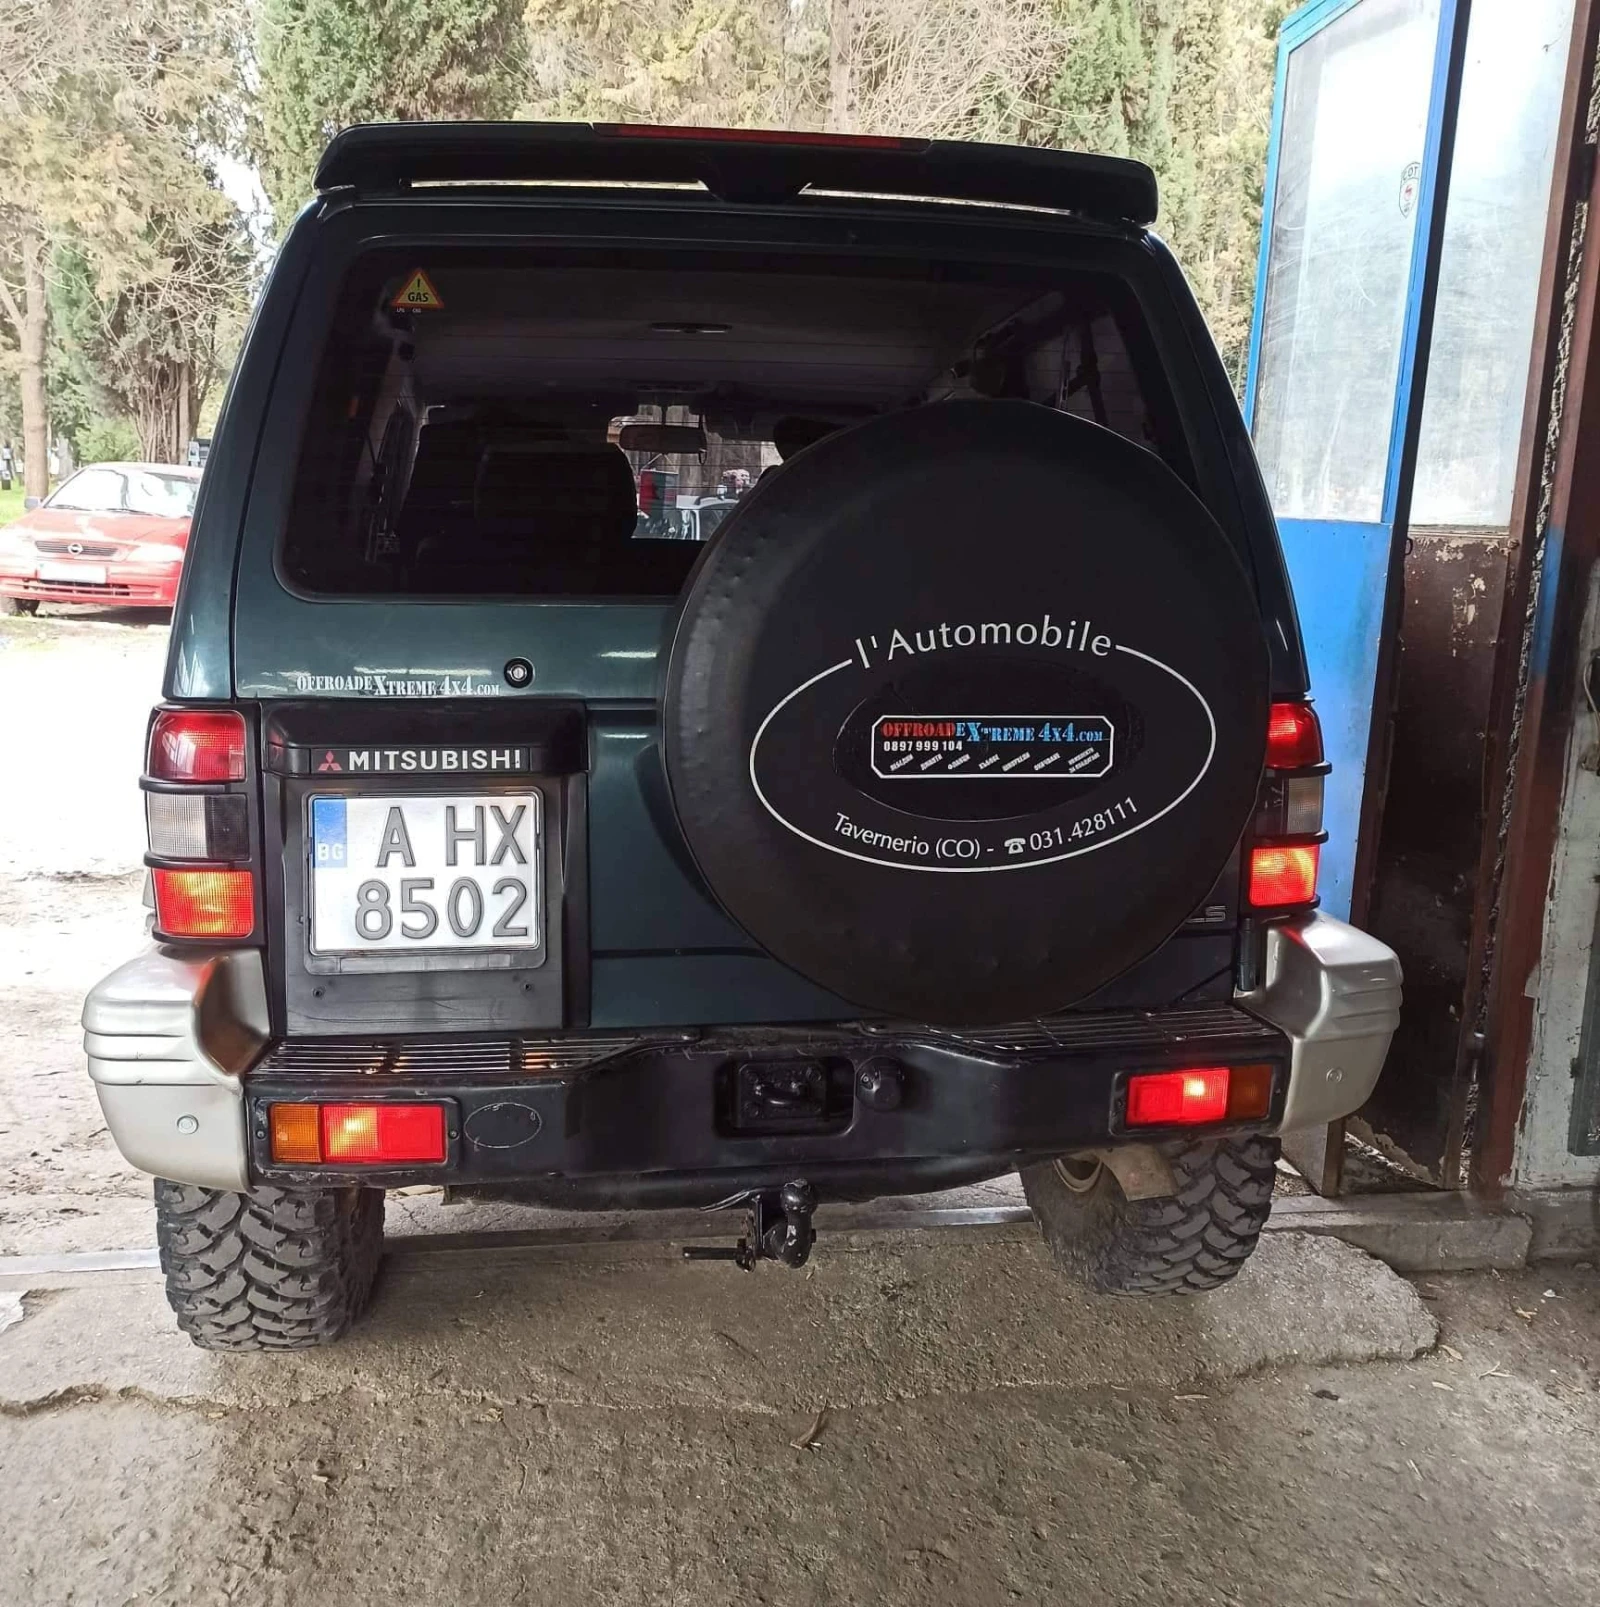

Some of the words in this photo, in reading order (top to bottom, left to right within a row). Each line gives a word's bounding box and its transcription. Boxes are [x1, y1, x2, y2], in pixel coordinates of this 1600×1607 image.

[407, 291, 429, 303] GAS
[855, 614, 1111, 669] l'Automobile
[350, 750, 520, 771] MITSUBISHI
[883, 740, 913, 752] 0897
[915, 740, 940, 752] 999
[942, 740, 963, 752] 104
[375, 806, 416, 868] A
[445, 804, 528, 867] HX
[832, 811, 930, 856] Tavernerio
[935, 838, 981, 859] (CO)
[1028, 797, 1139, 851] 031.428111
[318, 843, 344, 861] BG
[354, 876, 528, 941] 8502
